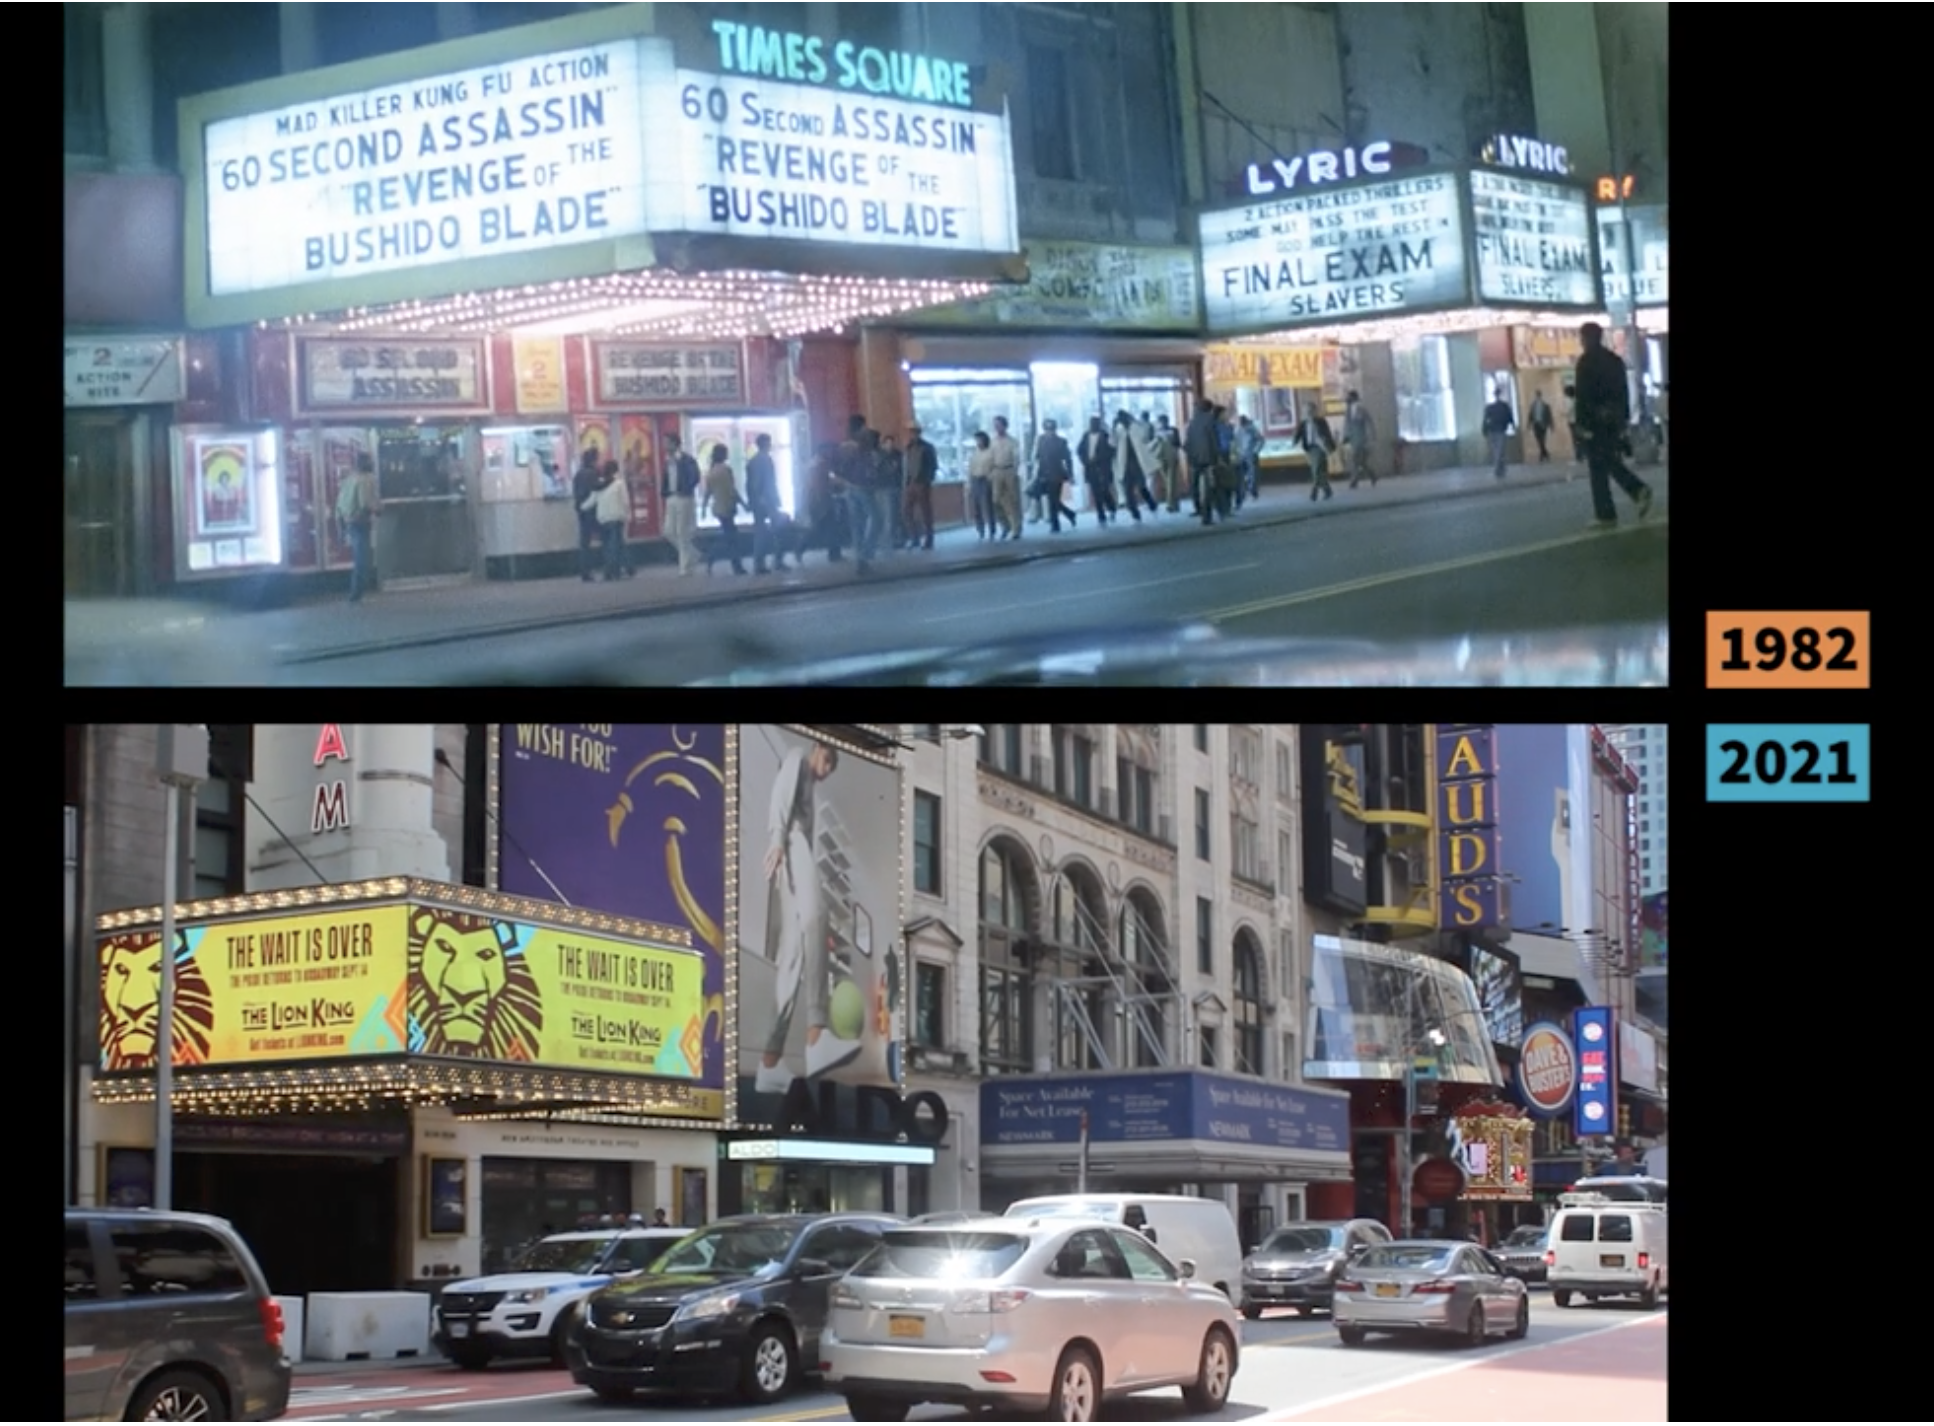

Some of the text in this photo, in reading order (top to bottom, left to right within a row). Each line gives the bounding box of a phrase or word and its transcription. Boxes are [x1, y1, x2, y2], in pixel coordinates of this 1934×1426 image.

[713, 20, 971, 105] TIMES SQUARE
[276, 54, 609, 137] MAD KILLER KUNG FU ACTION
[681, 84, 728, 122] 60
[269, 130, 402, 183] SECOND
[533, 162, 561, 187] OF
[568, 138, 612, 165] THE
[879, 155, 899, 175] OF
[909, 171, 940, 194] THE
[1248, 141, 1391, 194] LYRIC
[1499, 134, 1569, 175] LYRIC
[1258, 199, 1303, 219] ACTION
[1307, 190, 1361, 210] PACKED
[1365, 177, 1444, 200] THRILLERS
[1227, 228, 1261, 243] SOME
[1310, 213, 1343, 229] PASS
[1354, 206, 1377, 222] THE
[1392, 199, 1428, 216] TEST
[1311, 232, 1348, 248] HELP
[1393, 217, 1431, 236] REST
[305, 214, 461, 270] BUSHIDO
[1478, 232, 1535, 269] FINAL
[1540, 238, 1590, 272] EXAM
[1222, 257, 1318, 298] FINAL
[93, 347, 112, 366] 2
[1269, 351, 1319, 377] EXAM
[77, 371, 131, 384] ACTION
[517, 724, 564, 760] WISH
[227, 923, 373, 969] THE WAIT IS OVER
[557, 944, 673, 992] THE WAIT IS OVER
[242, 998, 354, 1031] THE LION KING
[572, 1015, 661, 1045] THE LION KING
[1526, 1045, 1556, 1073] DAVE
[1557, 1043, 1569, 1066] &
[777, 1077, 948, 1142] ALDO
[999, 1089, 1034, 1105] Space
[1039, 1086, 1094, 1101] Available
[1023, 1105, 1045, 1118] Net
[731, 1142, 775, 1157] ALDO
